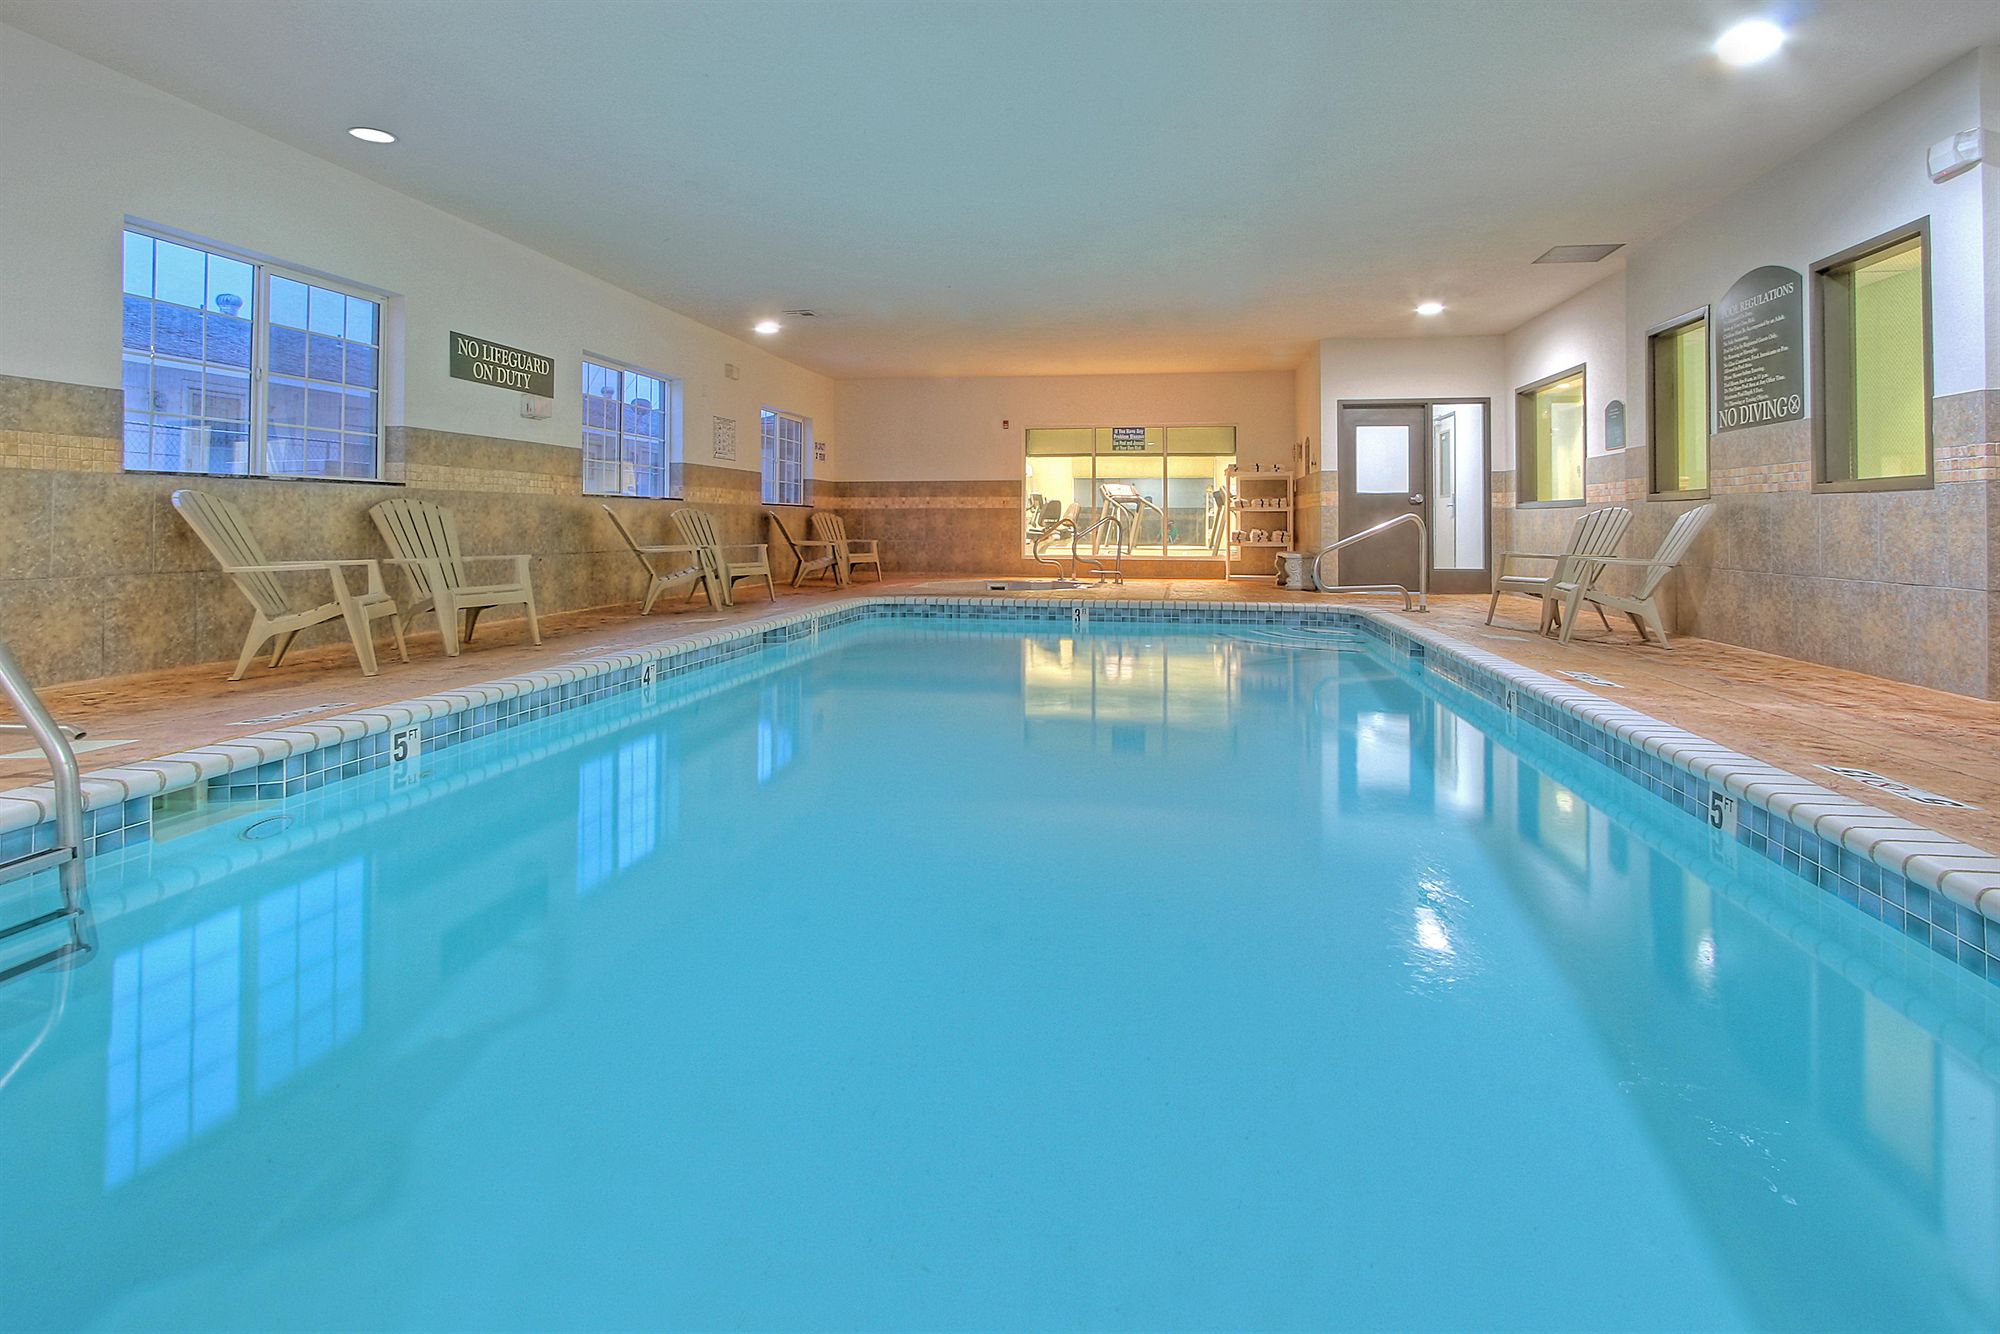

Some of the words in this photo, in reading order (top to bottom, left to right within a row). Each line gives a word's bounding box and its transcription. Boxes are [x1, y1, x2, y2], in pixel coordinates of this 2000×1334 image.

[1740, 282, 1794, 311] REGULATIONS
[457, 337, 480, 359] NO
[482, 344, 550, 375] LIFEGUARD
[473, 362, 494, 382] ON
[496, 366, 531, 390] DUTY
[1719, 407, 1737, 428] NO
[1740, 397, 1788, 425] DIVING
[1074, 608, 1081, 621] 3
[643, 666, 650, 685] 4
[394, 731, 408, 761] 5
[408, 728, 418, 741] FT
[1710, 790, 1723, 830] 5
[1724, 797, 1734, 813] FT
